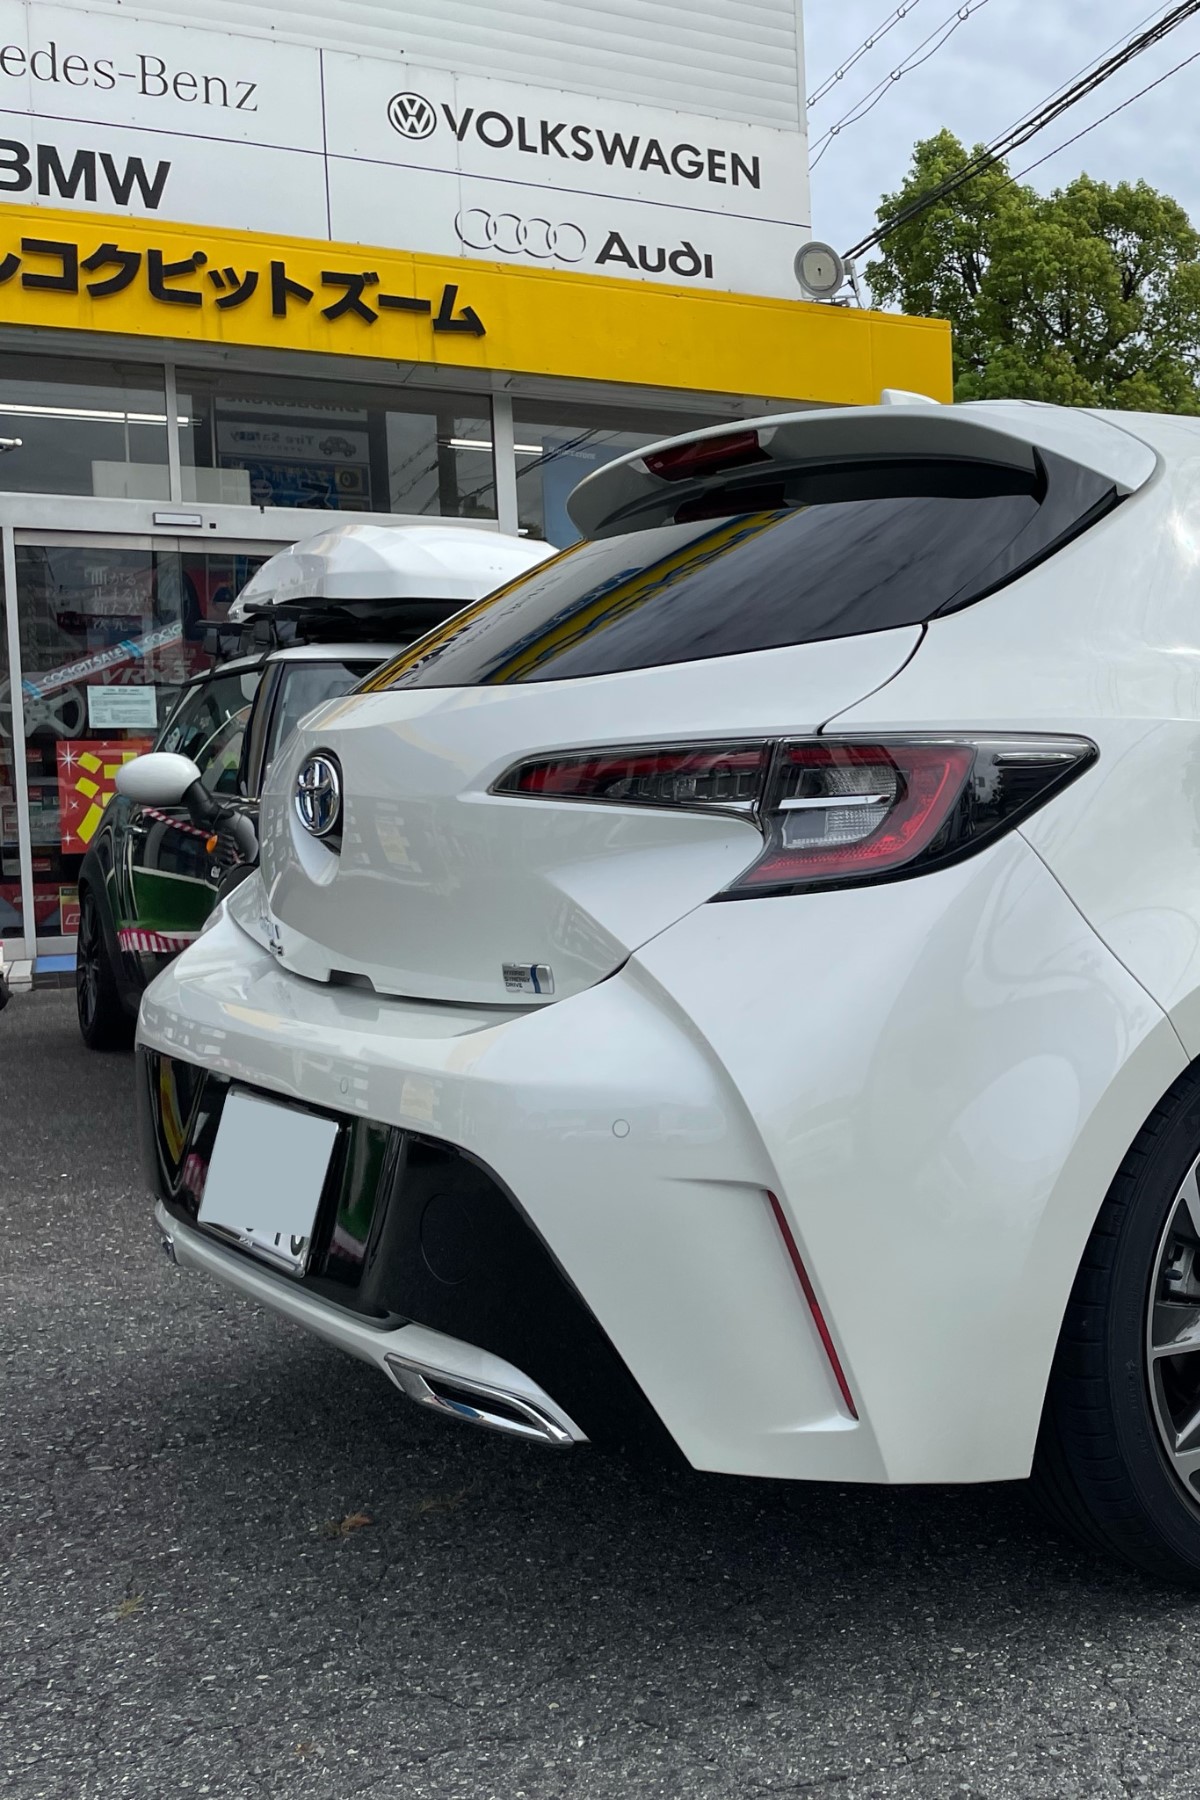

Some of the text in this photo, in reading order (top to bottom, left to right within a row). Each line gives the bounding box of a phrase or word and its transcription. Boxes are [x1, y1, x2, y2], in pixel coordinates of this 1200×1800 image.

[0, 138, 172, 210] BMW
[441, 103, 760, 190] VOLKSWAGEN
[595, 231, 713, 279] Audi
[93, 646, 124, 665] SALE
